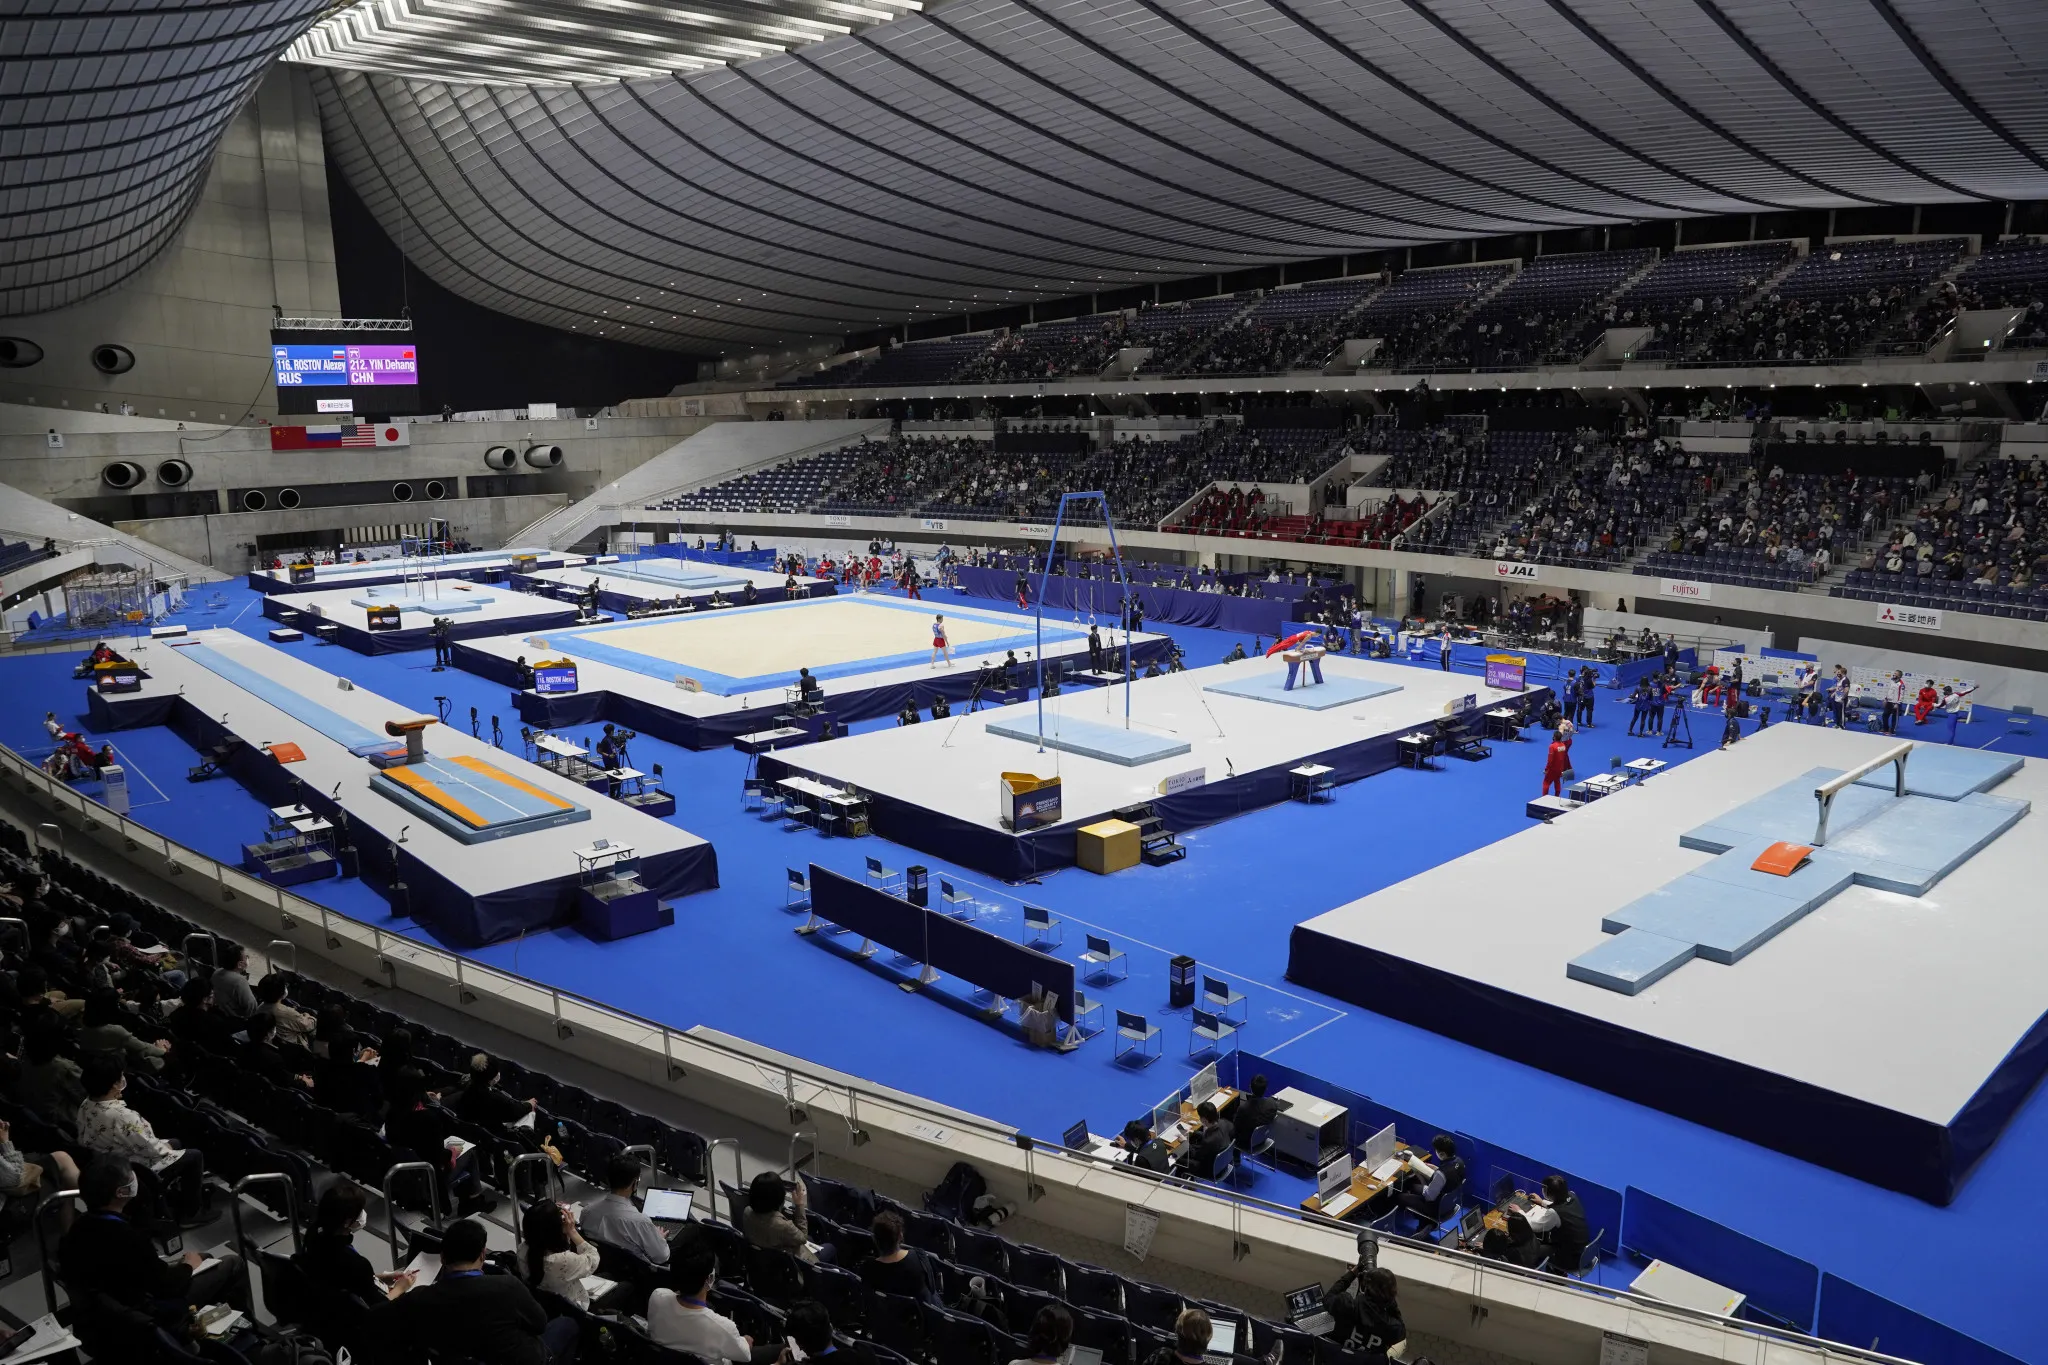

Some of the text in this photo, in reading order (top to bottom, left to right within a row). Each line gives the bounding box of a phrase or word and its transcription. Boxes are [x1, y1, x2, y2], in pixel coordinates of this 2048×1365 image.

[277, 360, 346, 373] 116. ROSTOV Alexey
[350, 360, 415, 372] 212. YIN Dehang
[278, 373, 302, 384] RUS
[351, 373, 374, 384] CHN
[931, 522, 944, 530] VTB
[1510, 565, 1535, 577] JAL
[1672, 584, 1699, 596] FUJITSU
[1898, 612, 1937, 626] 三菱地所
